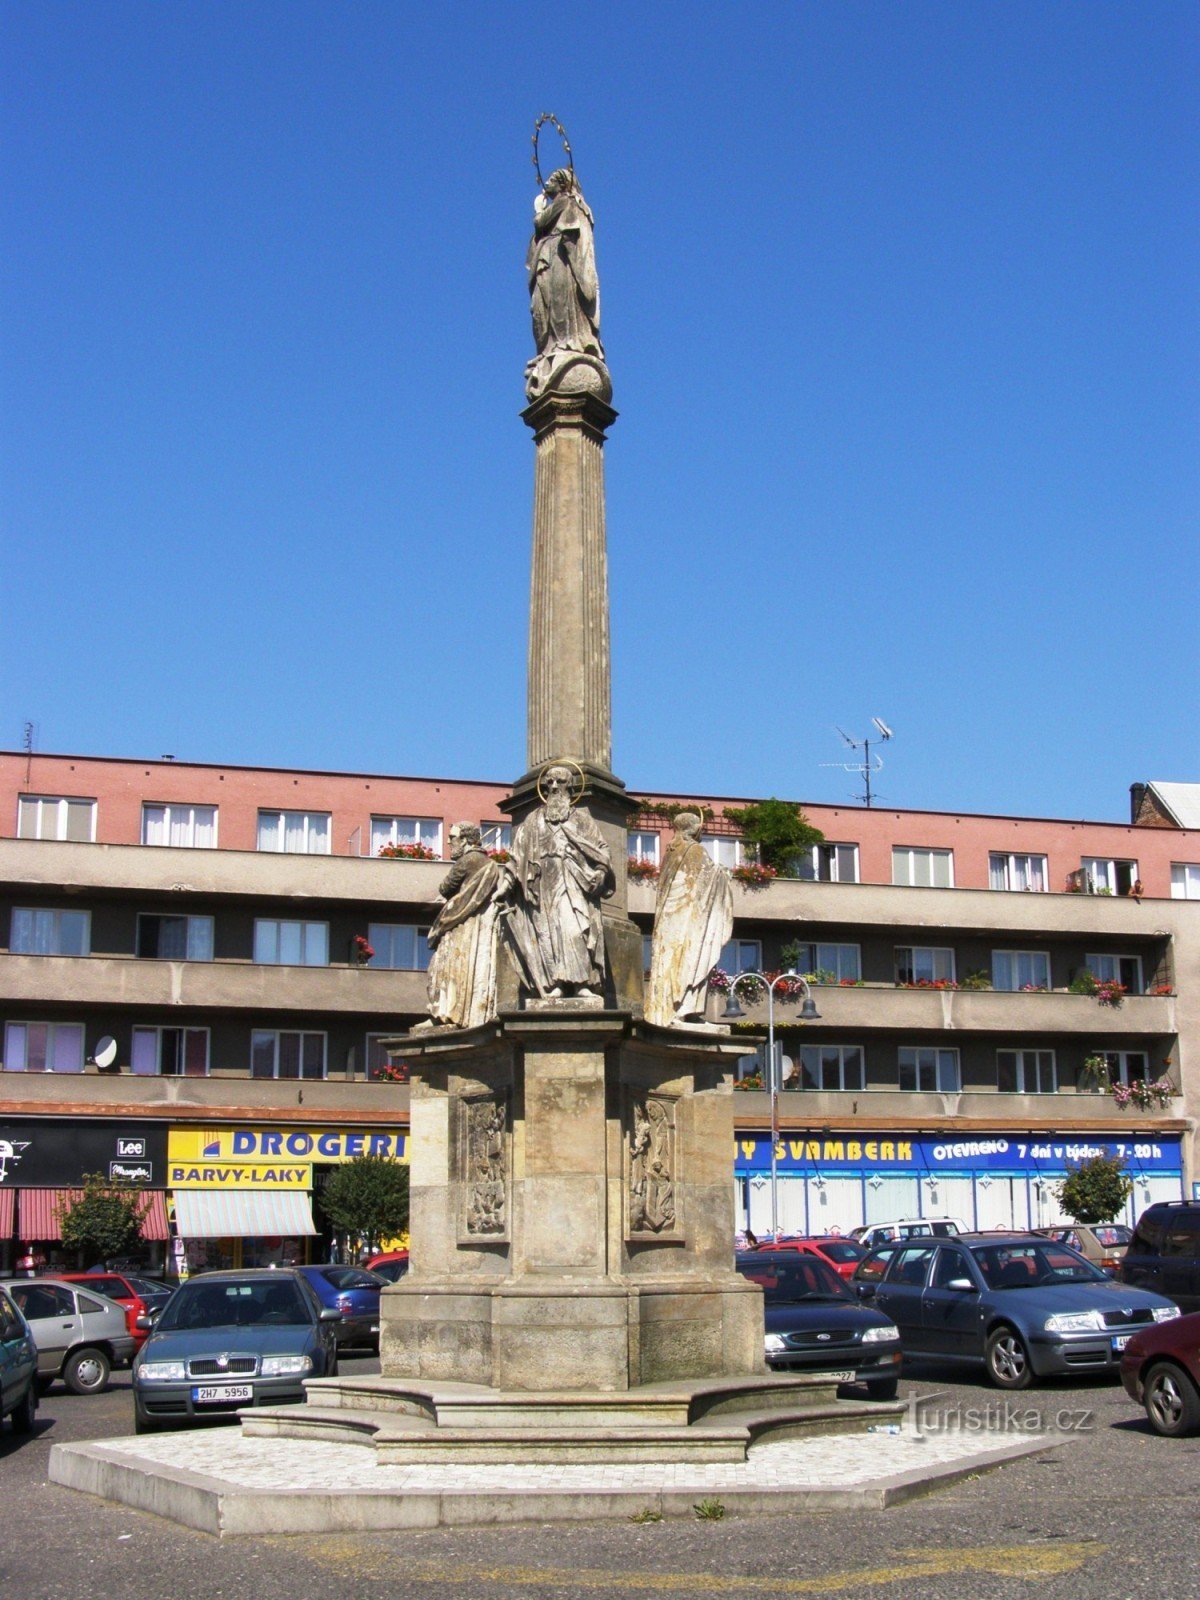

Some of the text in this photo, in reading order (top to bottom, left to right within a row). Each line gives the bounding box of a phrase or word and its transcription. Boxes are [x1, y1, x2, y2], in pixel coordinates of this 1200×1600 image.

[119, 1141, 143, 1155] Lee
[233, 1131, 406, 1158] DROGERI
[735, 1140, 913, 1161] Y SVAMBERK
[1017, 1144, 1027, 1158] 7
[1030, 1144, 1052, 1159] dní
[1054, 1148, 1063, 1158] v
[172, 1168, 308, 1182] BARVY-LAKY
[200, 1386, 249, 1399] 2H7 5956
